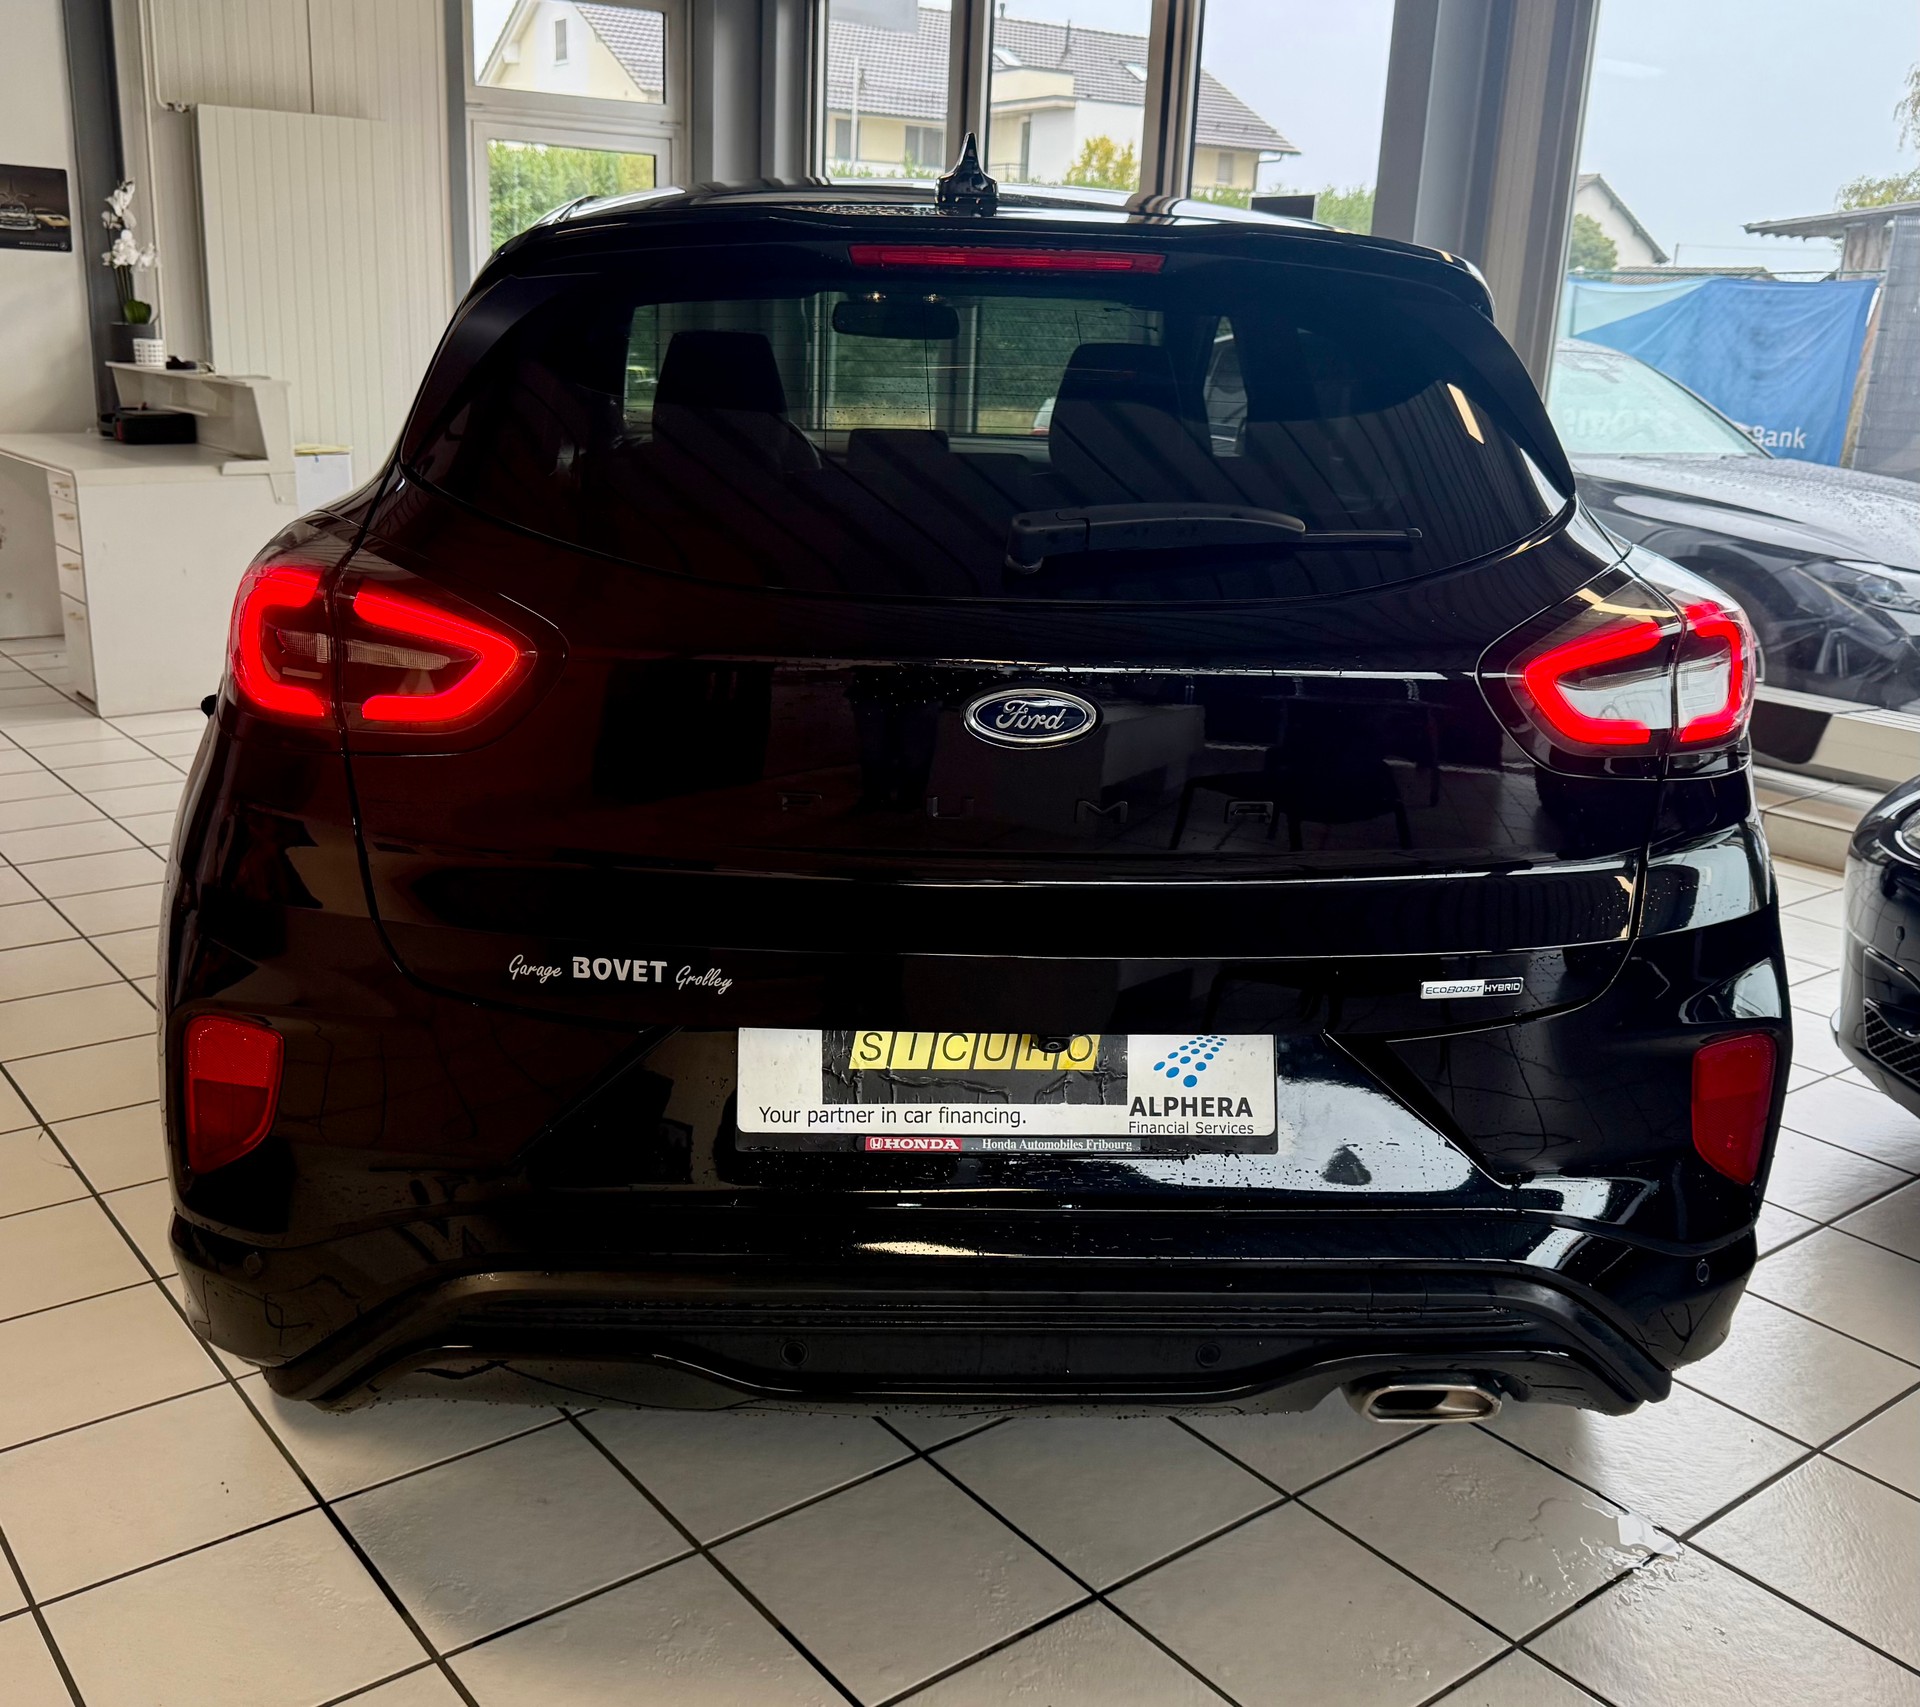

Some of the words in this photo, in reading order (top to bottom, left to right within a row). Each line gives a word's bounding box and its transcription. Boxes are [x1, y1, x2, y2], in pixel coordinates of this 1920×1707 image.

[1752, 425, 1807, 449] Bank
[995, 700, 1067, 730] Ford
[508, 954, 563, 984] Garage
[572, 956, 668, 983] BOVET
[675, 965, 734, 995] Grolley
[1484, 982, 1521, 993] HYBRID
[759, 1106, 801, 1124] Your
[808, 1107, 875, 1128] partner
[882, 1106, 897, 1124] in
[904, 1109, 933, 1124] car
[939, 1106, 1027, 1129] financing.
[1129, 1096, 1254, 1118] ALPHERA
[1128, 1121, 1189, 1135] Financial
[1195, 1121, 1255, 1136] Services
[883, 1138, 960, 1150] HONDA
[981, 1138, 1017, 1151] Honda
[1019, 1138, 1084, 1151] Automobiles
[1087, 1138, 1133, 1152] Fribourg
